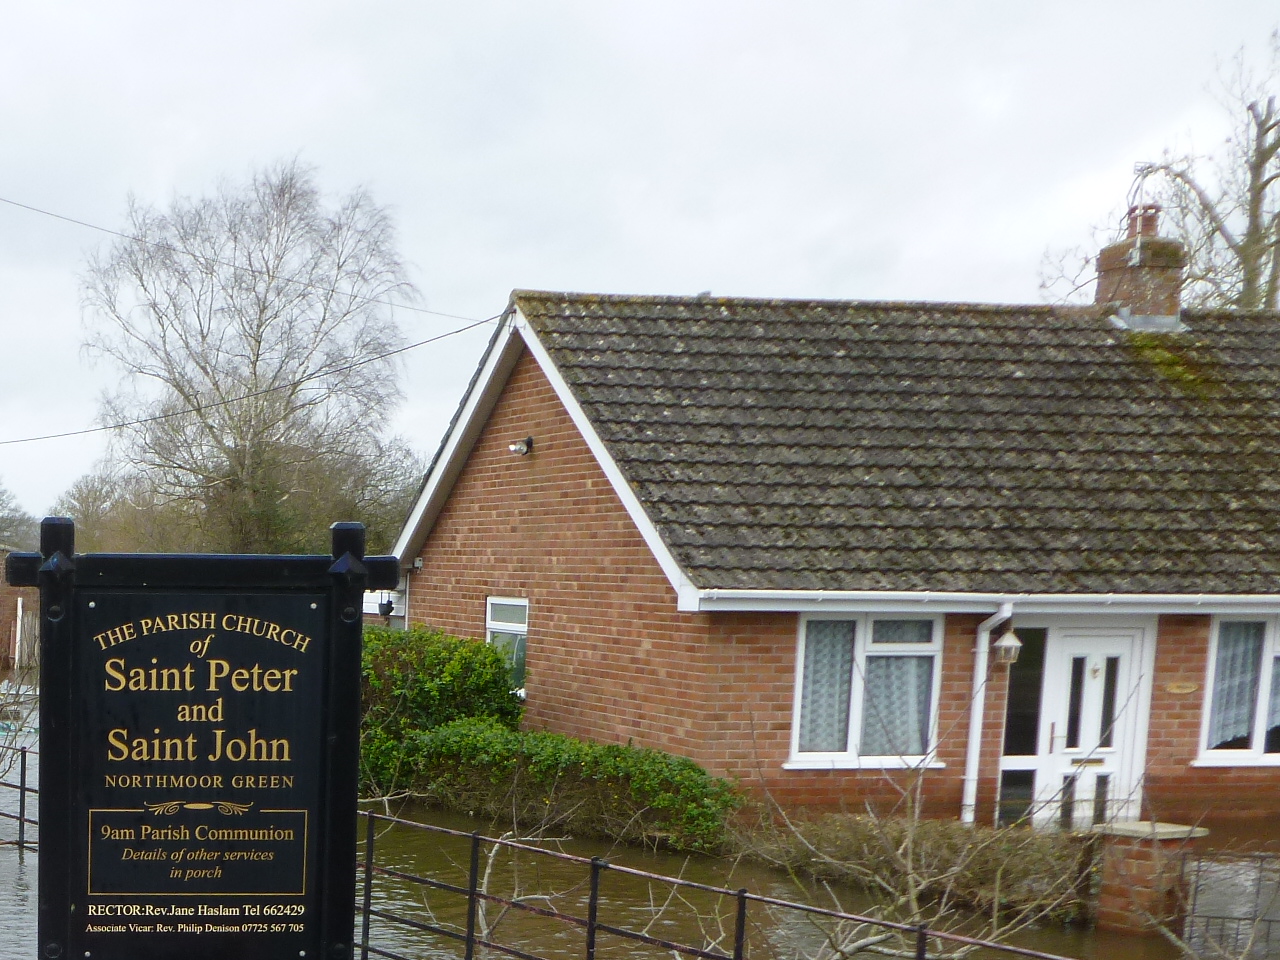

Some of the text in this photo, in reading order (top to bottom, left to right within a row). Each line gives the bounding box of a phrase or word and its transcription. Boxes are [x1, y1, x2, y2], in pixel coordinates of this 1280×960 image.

[93, 613, 312, 653] THE PARISH CHURCH
[189, 634, 214, 658] of
[105, 658, 298, 692] Saint Peter
[177, 698, 224, 722] and
[107, 728, 291, 761] Saint John
[104, 775, 294, 788] NORTHMOOR GREEN
[101, 825, 294, 840] 9am Parish Communion
[122, 848, 274, 863] Details of other services
[170, 866, 222, 881] in porch
[198, 905, 240, 916] Haslam
[243, 905, 260, 916] Tel
[263, 905, 305, 916] 662429
[86, 924, 126, 932] Associate
[156, 924, 175, 932] Rev.
[178, 924, 202, 934] Philip
[205, 924, 239, 932] Denison
[241, 924, 267, 932] 07725
[270, 924, 286, 932] 567
[288, 924, 304, 932] 705
